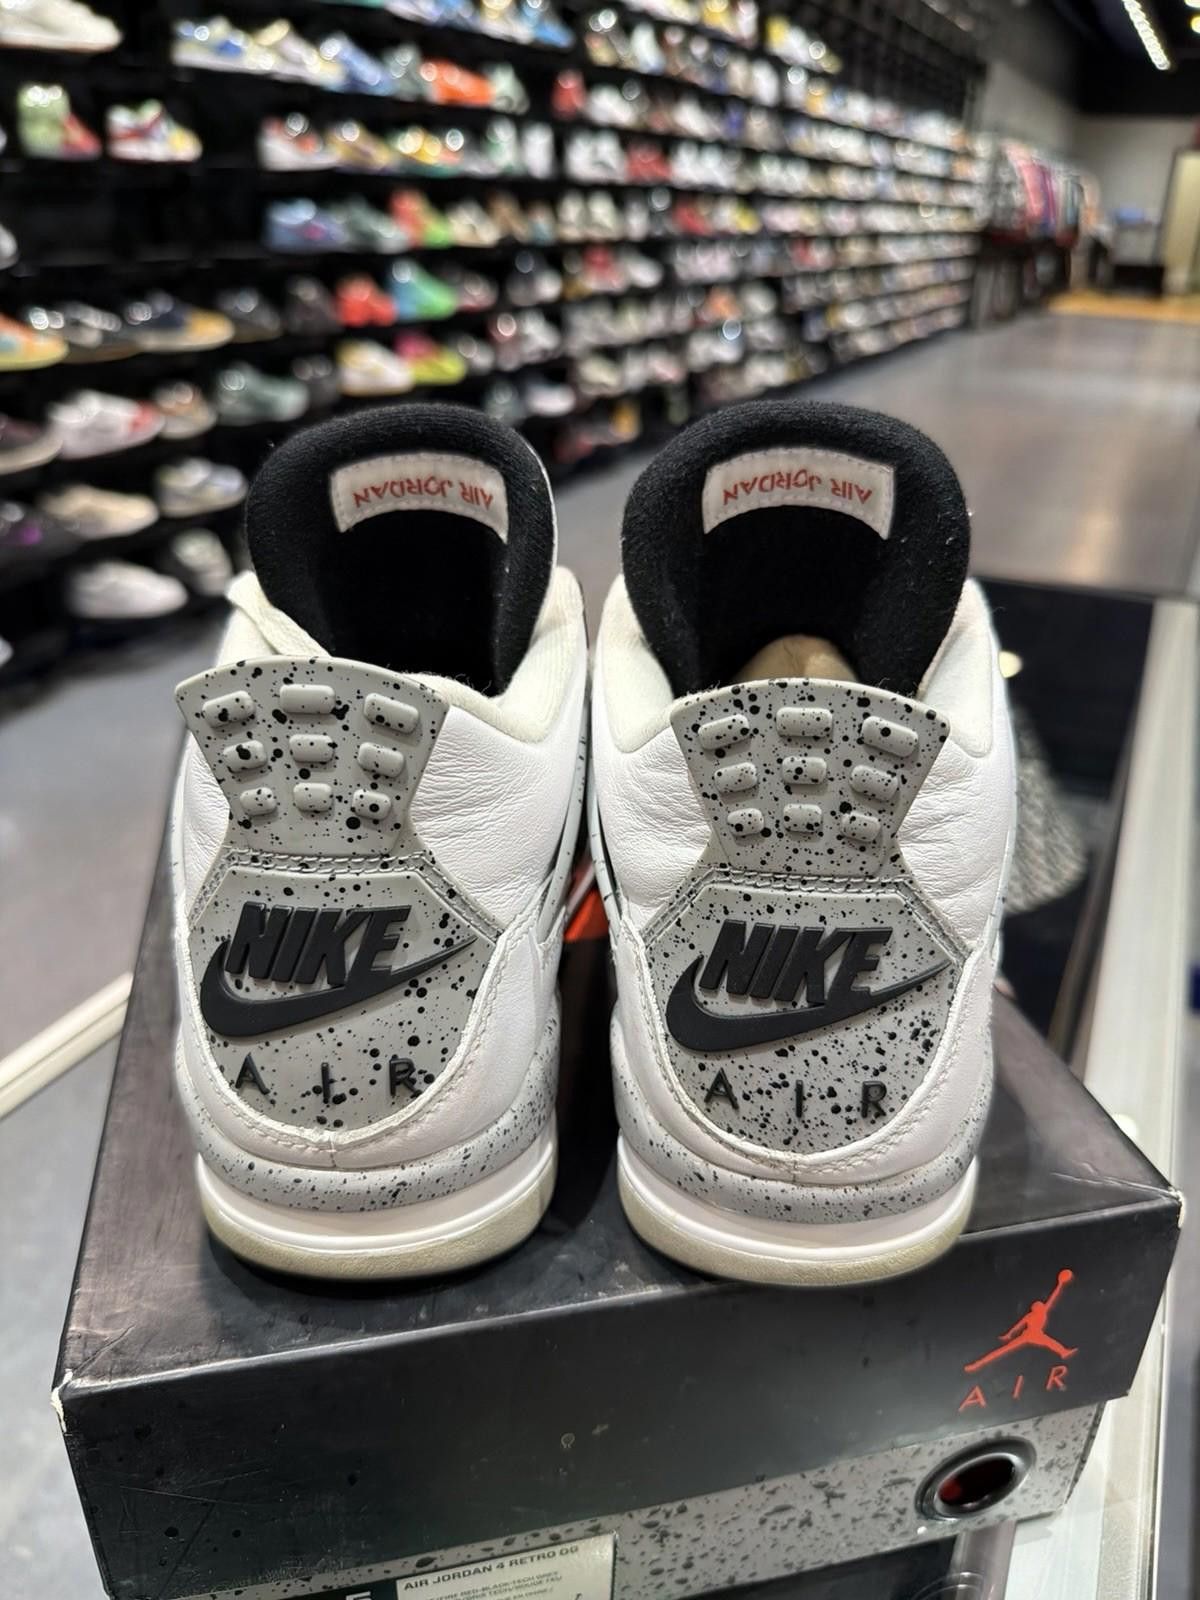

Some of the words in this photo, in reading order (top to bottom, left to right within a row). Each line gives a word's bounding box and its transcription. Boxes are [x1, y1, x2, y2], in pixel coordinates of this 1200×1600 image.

[352, 474, 453, 508] JORDAN
[459, 481, 494, 511] AIR
[722, 468, 822, 506] JORDAN
[830, 477, 873, 505] AIR
[224, 900, 412, 986] NIKE
[699, 918, 893, 1006] NIKE
[234, 1052, 423, 1104] AIR
[703, 1067, 887, 1118] AIR
[958, 1365, 1068, 1413] AIR
[404, 1579, 429, 1591] AIR
[432, 1564, 493, 1585] JORDAN
[496, 1561, 505, 1570] 4
[508, 1550, 557, 1568] RETRO
